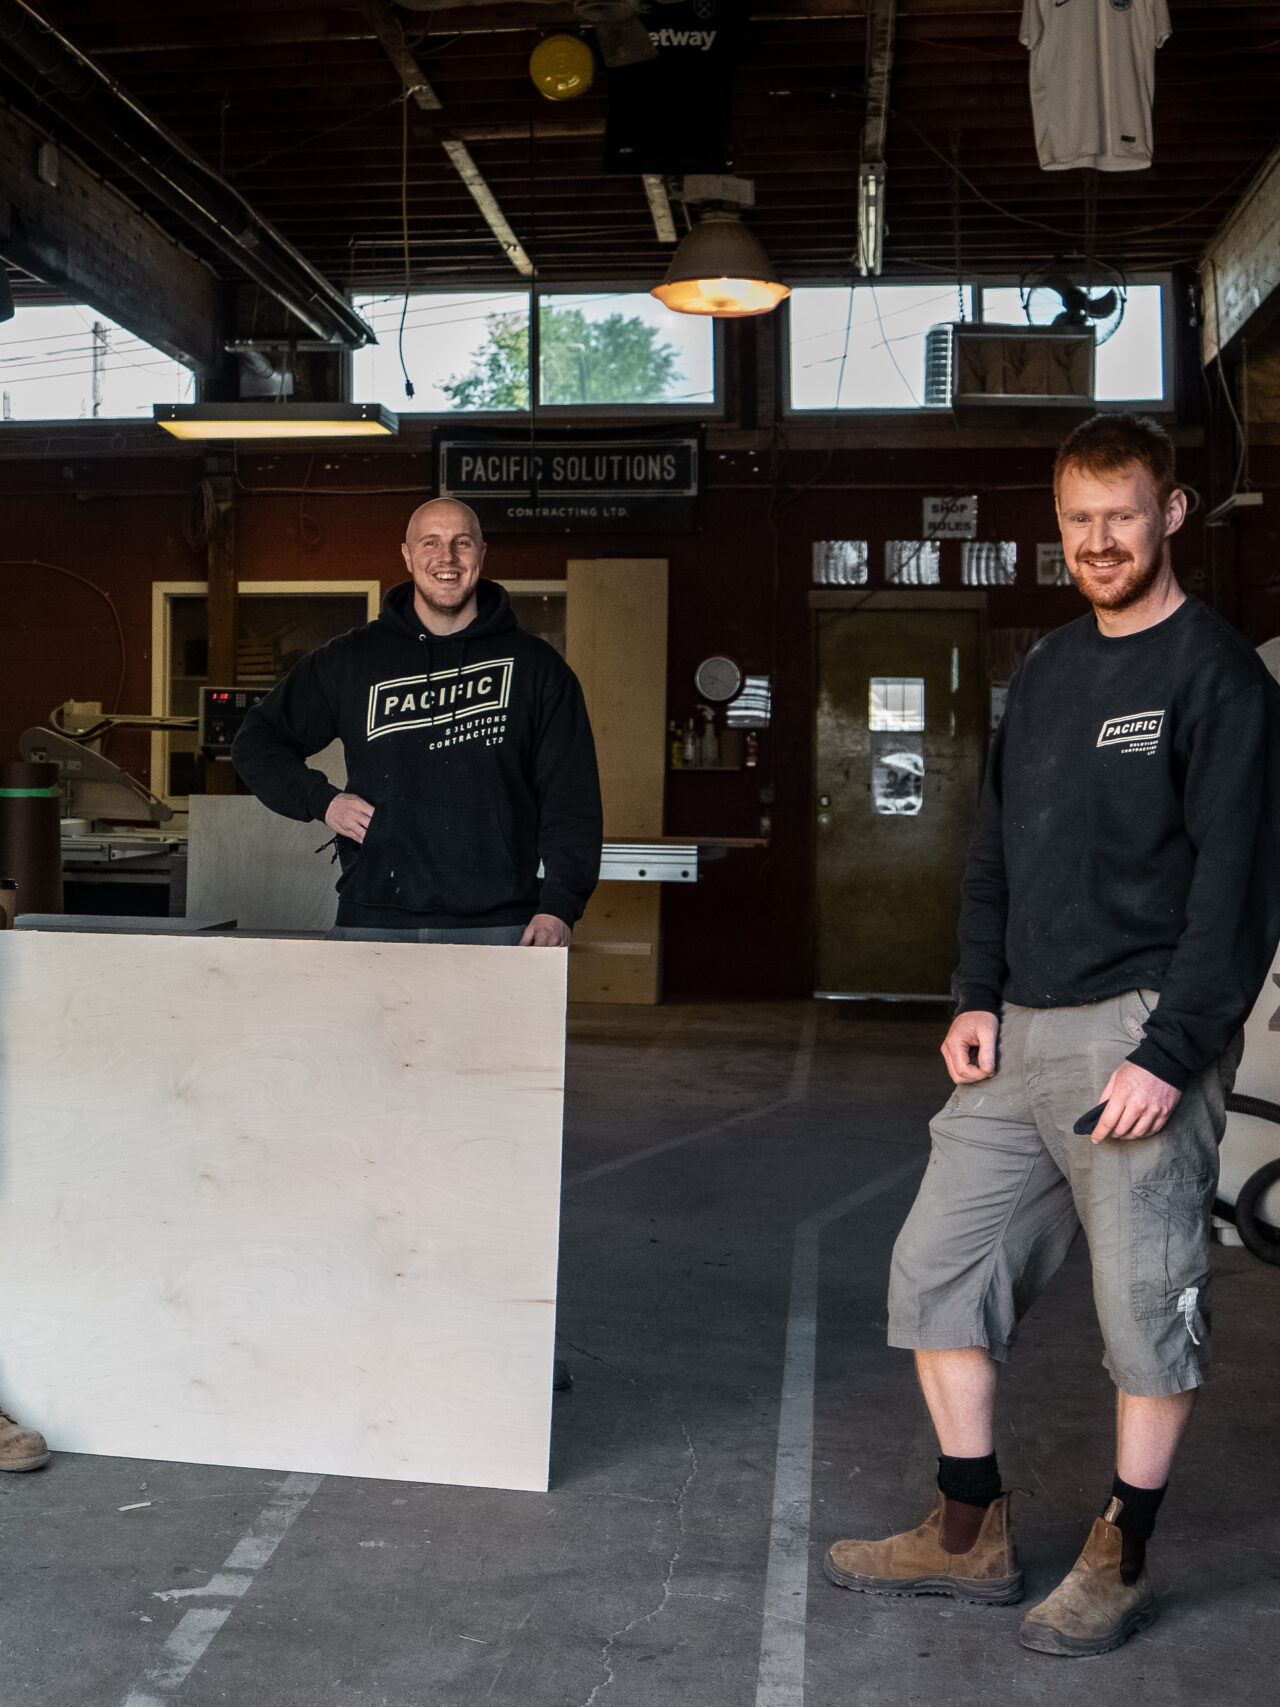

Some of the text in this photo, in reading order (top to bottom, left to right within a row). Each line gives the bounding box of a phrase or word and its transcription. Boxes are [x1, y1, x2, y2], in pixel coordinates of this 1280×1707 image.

[648, 28, 717, 51] etway
[461, 454, 677, 482] PACIFIC SOLUTIONS
[507, 507, 598, 518] CONTRACTING
[931, 503, 968, 514] SHOP
[928, 521, 972, 532] RULES
[384, 676, 493, 716] PACIFIC
[445, 714, 507, 736] SOLUTIONS
[1105, 719, 1158, 737] PACIFIC
[429, 725, 506, 751] CONTRACTING
[486, 736, 504, 747] LTD
